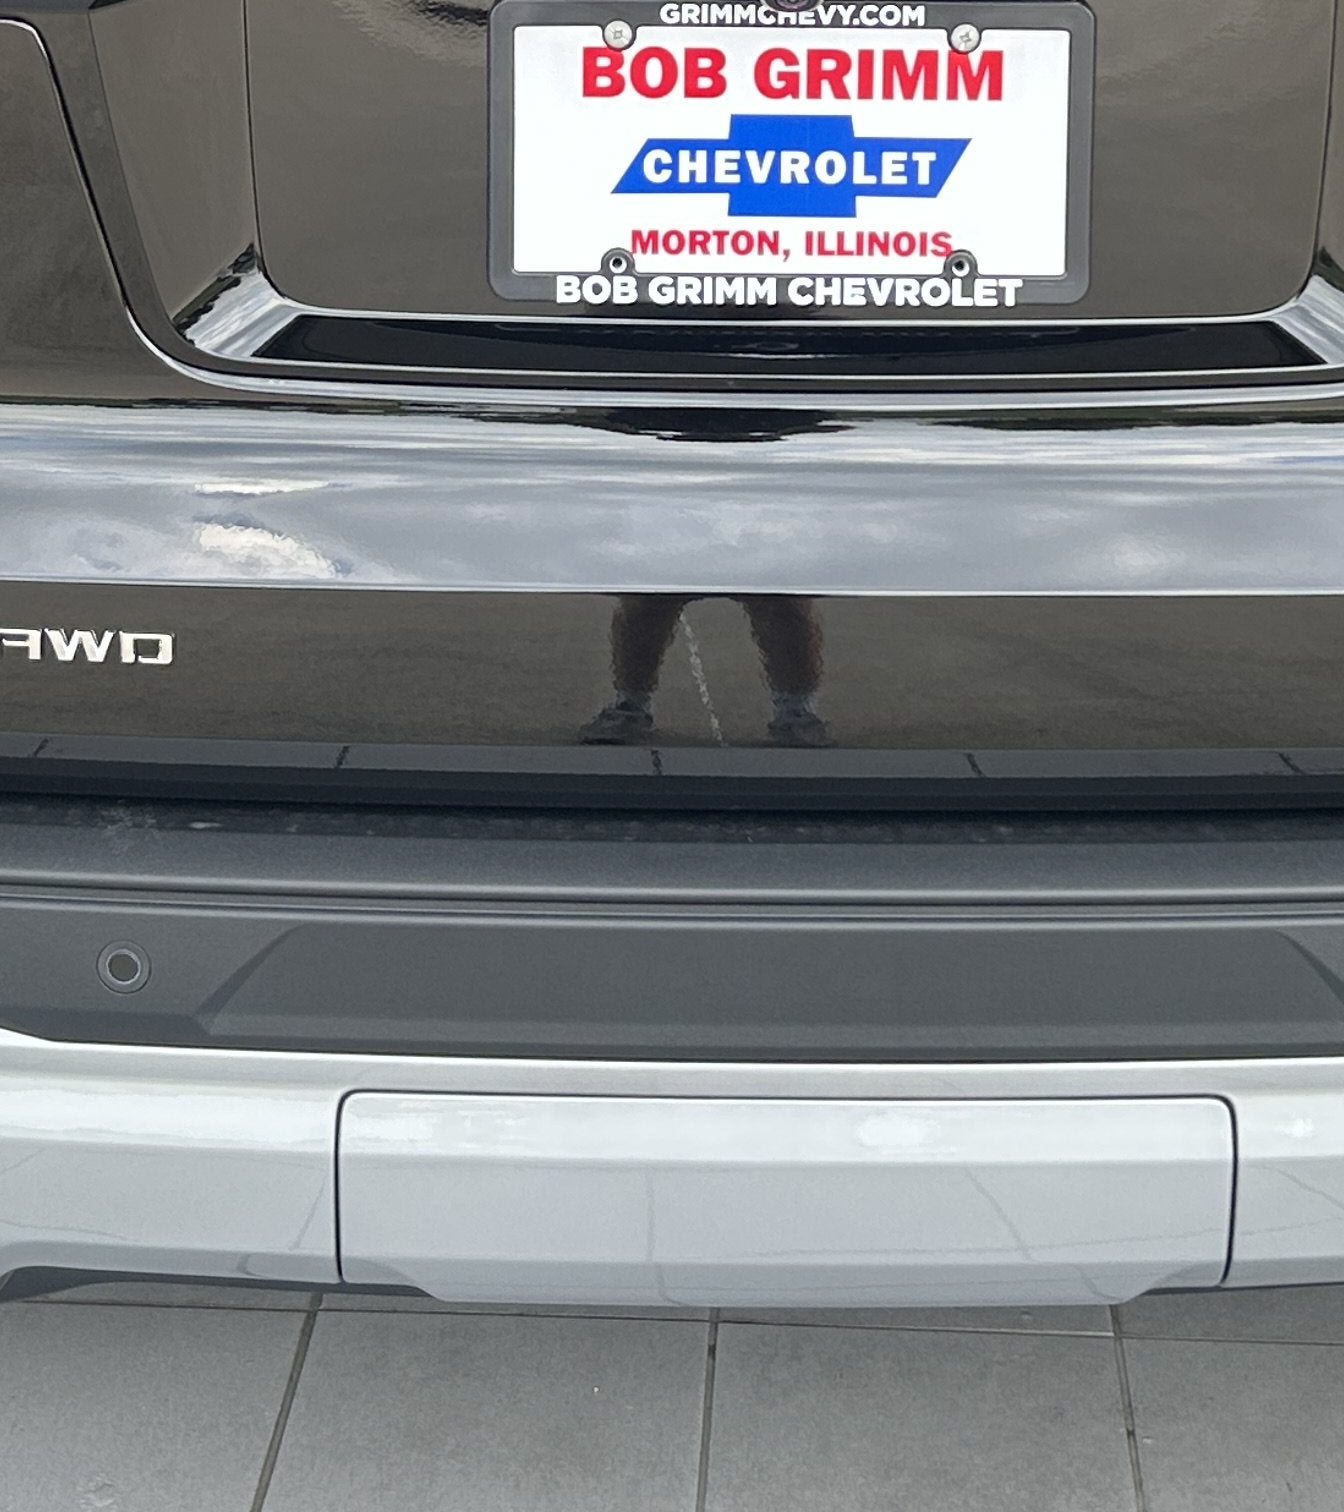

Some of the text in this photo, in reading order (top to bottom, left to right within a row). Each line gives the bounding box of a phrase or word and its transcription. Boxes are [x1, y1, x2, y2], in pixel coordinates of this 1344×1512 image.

[659, 2, 926, 27] GRIMMCHEVY.COM
[582, 46, 1004, 102] BOB GRIMM
[642, 149, 937, 187] CHEVROLET
[631, 229, 953, 263] MORTON, ILLINOIS
[556, 275, 1024, 309] BOB GRIMM CHEVROLET
